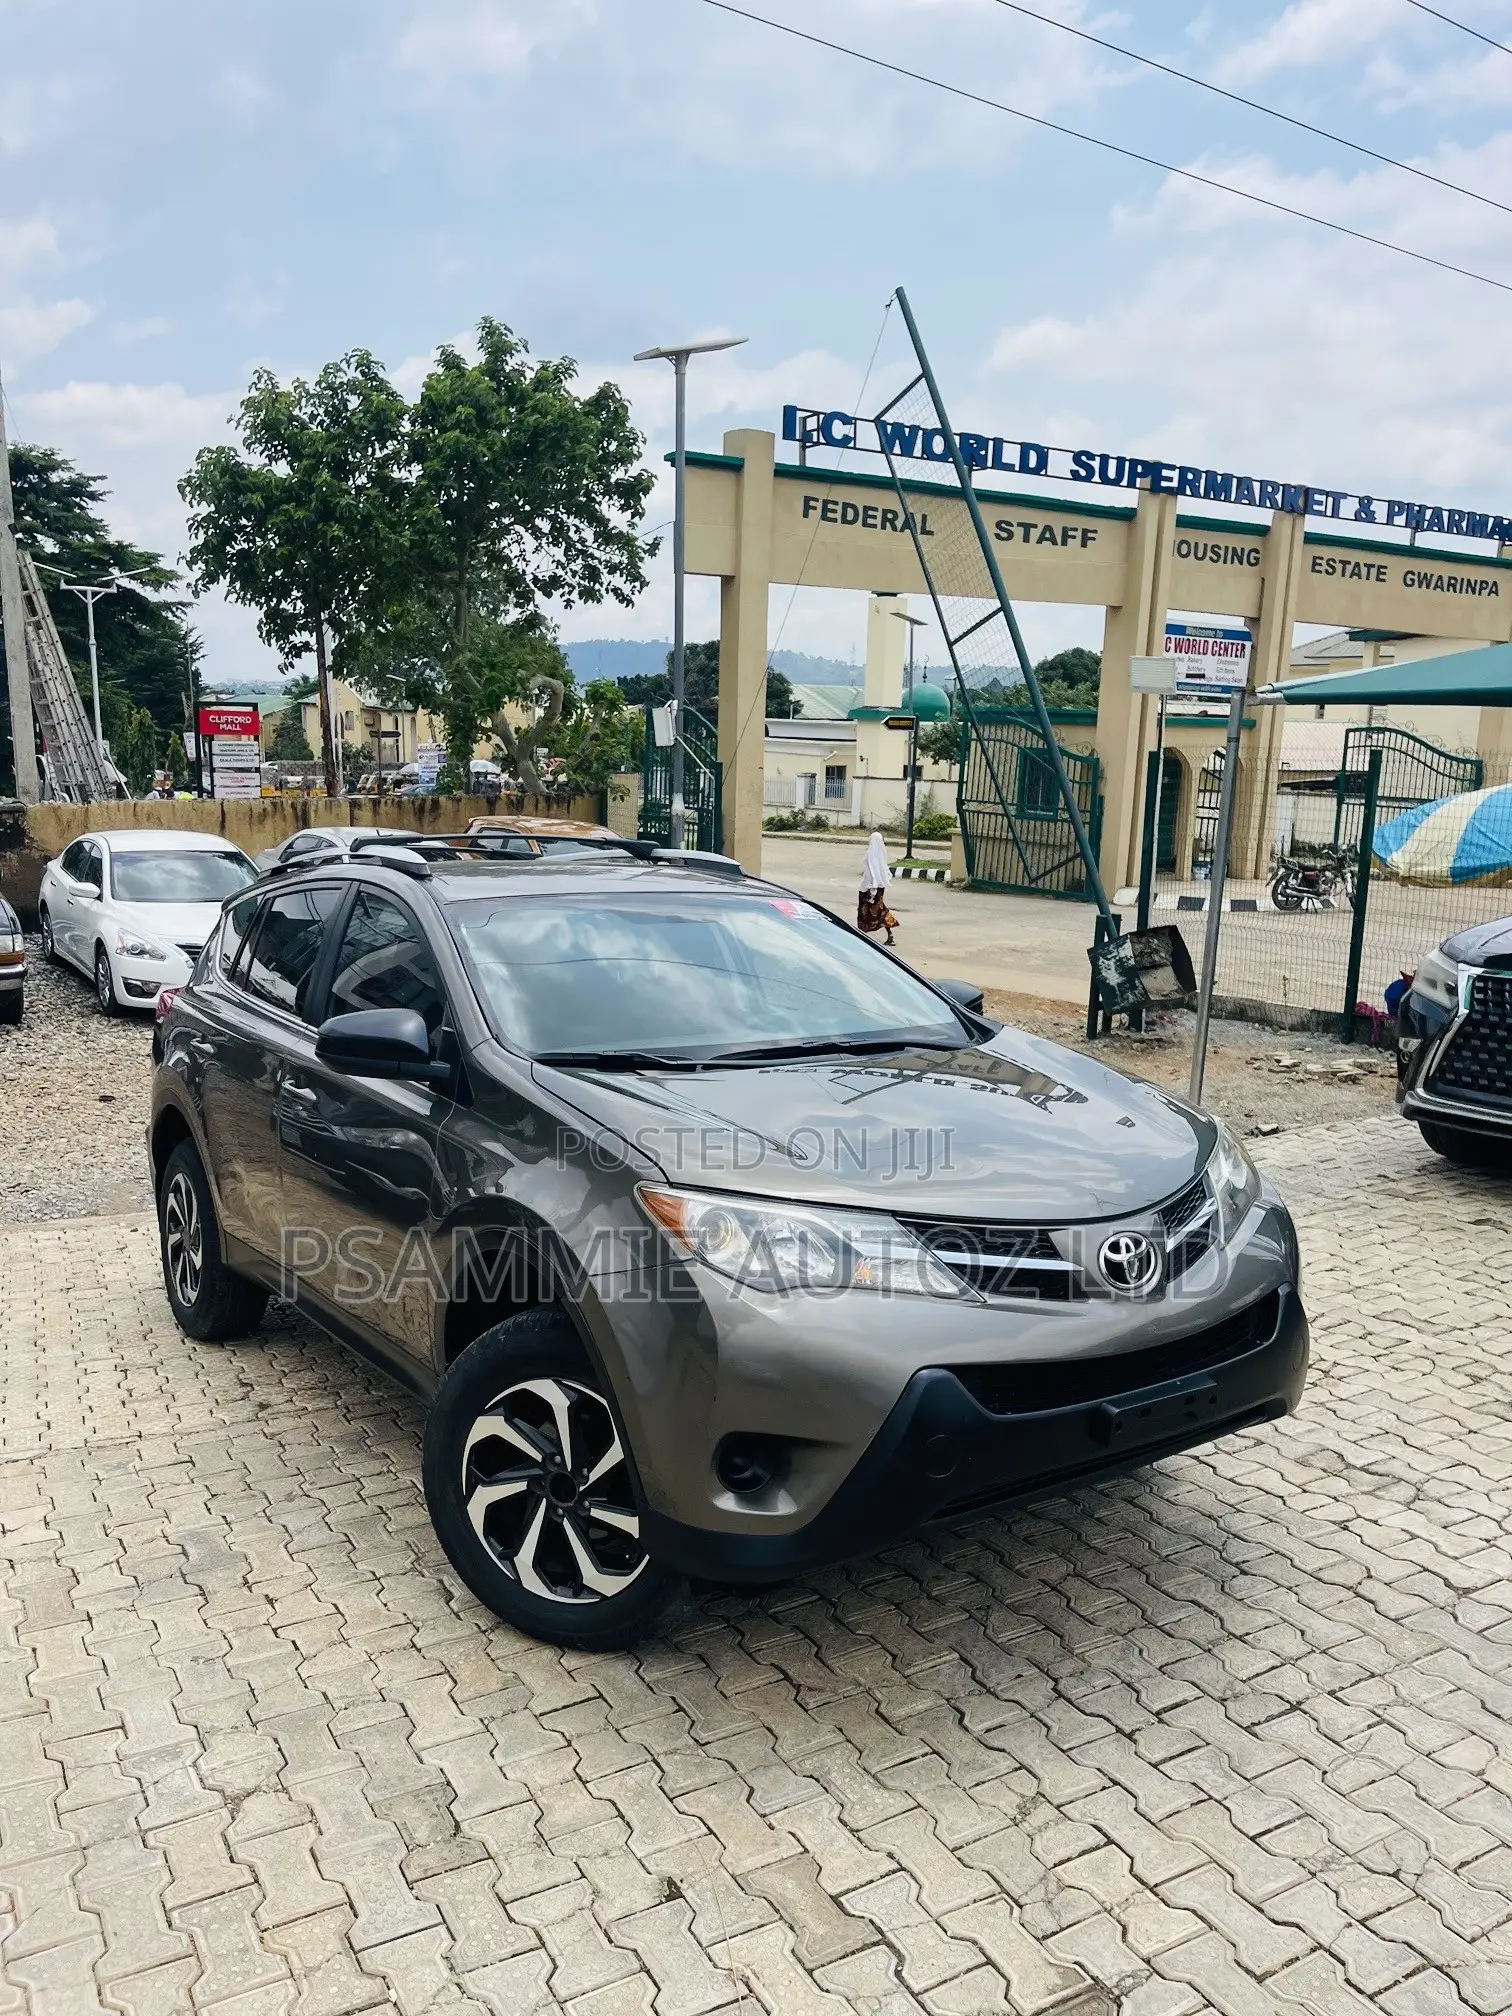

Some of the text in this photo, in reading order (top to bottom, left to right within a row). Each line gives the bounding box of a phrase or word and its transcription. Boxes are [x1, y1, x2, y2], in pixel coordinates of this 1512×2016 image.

[876, 419, 1047, 475] WORLD
[1070, 449, 1347, 518] SUPERMARKET
[1355, 495, 1376, 523] &
[1387, 500, 1512, 542] PHARMA
[802, 495, 1500, 597] FEDERAL STAFF OUSING ESTATE GWARINPA
[1174, 637, 1209, 656] WORLD
[1211, 640, 1246, 658] CENTER
[209, 715, 252, 724] CLIFFORD
[220, 723, 242, 731] MALL
